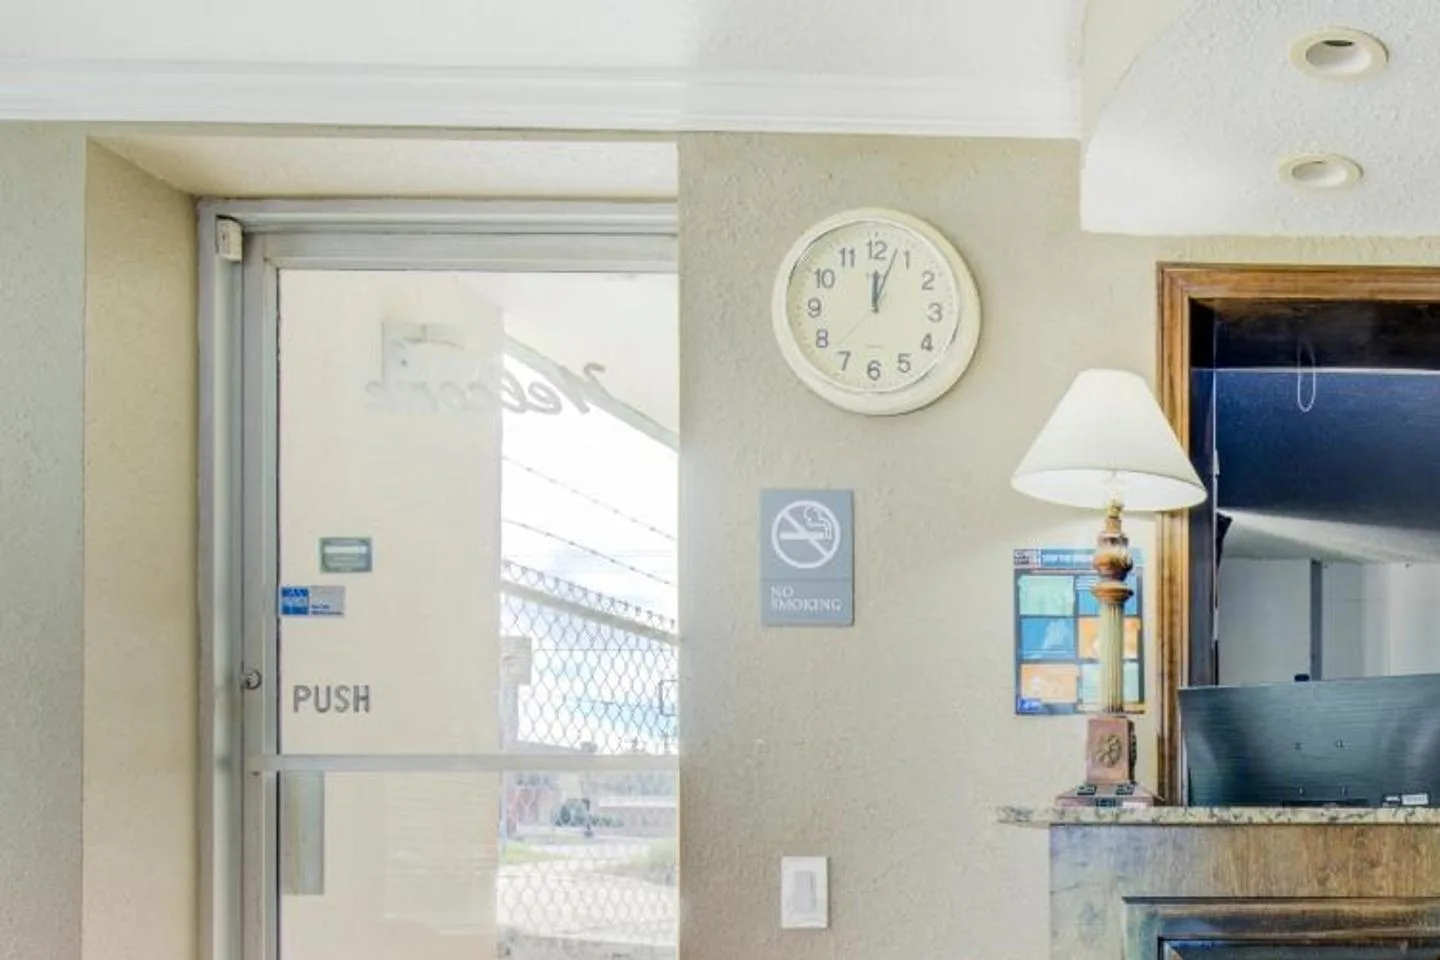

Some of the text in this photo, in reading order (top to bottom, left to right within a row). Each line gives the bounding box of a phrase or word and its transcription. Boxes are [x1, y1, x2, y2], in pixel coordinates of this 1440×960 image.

[839, 248, 856, 269] 11
[866, 240, 888, 260] 12
[903, 250, 911, 270] 1
[814, 268, 835, 289] 10
[921, 271, 936, 291] 2
[807, 298, 822, 319] 9
[927, 303, 943, 323] 3
[815, 329, 829, 349] 8
[921, 333, 934, 352] 4
[838, 351, 851, 372] 7
[867, 360, 882, 381] 6
[898, 353, 912, 373] 5
[770, 585, 794, 598] NO
[770, 598, 843, 612] SMOKING
[293, 684, 371, 713] PUSH
